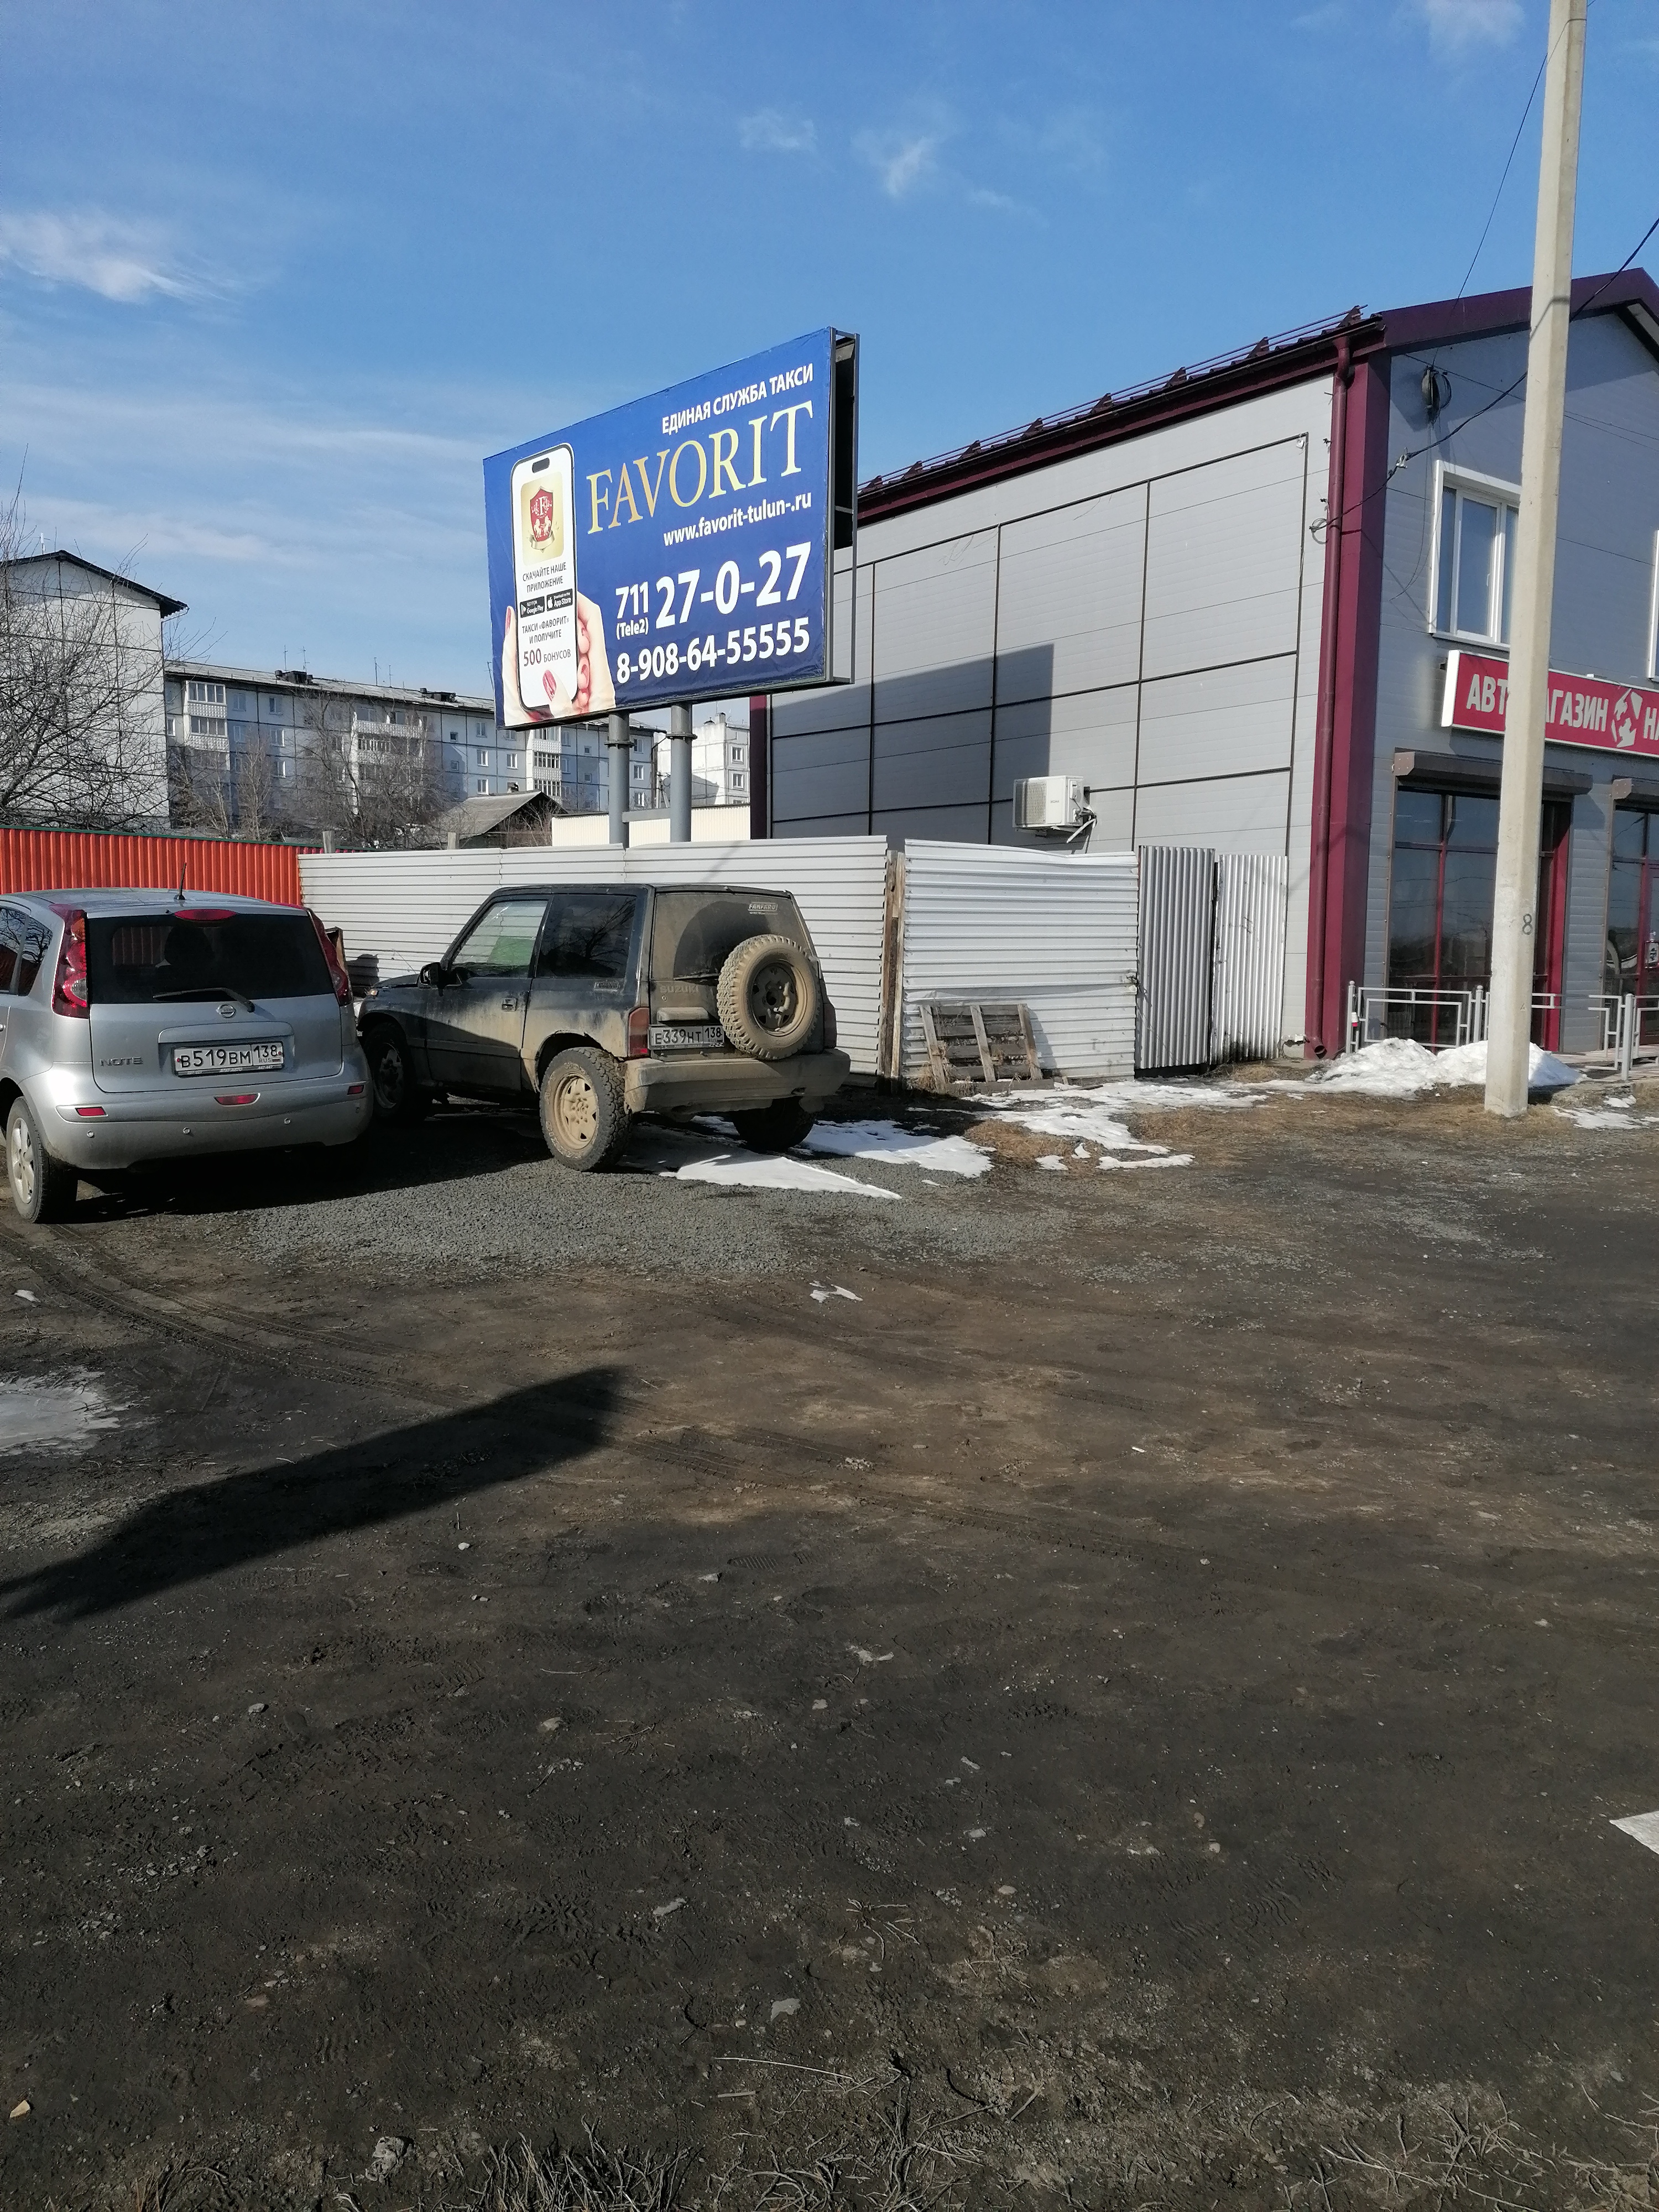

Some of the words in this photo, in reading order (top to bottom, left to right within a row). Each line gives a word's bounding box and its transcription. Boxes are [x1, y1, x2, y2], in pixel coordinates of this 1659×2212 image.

[662, 401, 711, 435] ЕДИНАЯ
[713, 381, 768, 415] СЛУЖБА
[769, 363, 813, 395] ТАКСИ
[586, 400, 813, 534] FAVORIT
[664, 492, 812, 546] www.favorit-tulun-.ru
[523, 566, 550, 582] СКАЧАЙТЕ
[551, 562, 567, 574] НАШЕ
[526, 576, 564, 593] ПРИЛОЖЕНИЕ
[615, 581, 649, 619] 711
[656, 541, 811, 629] 27-0-27
[522, 623, 538, 634] ТАКСИ
[529, 636, 534, 644] И
[534, 629, 562, 642] ПОЛУЧИТЕ
[616, 617, 649, 640] (Tele2)
[524, 648, 542, 667] 500
[544, 649, 571, 663] БОНУСОВ
[617, 617, 810, 684] 8-908-64-55555
[1466, 673, 1609, 732] АВТГАЗИН
[1522, 914, 1532, 935] 8
[660, 985, 700, 994] SUZUKI
[705, 1027, 721, 1039] 138
[253, 1045, 278, 1058] 138
[100, 1057, 143, 1067] NOTE
